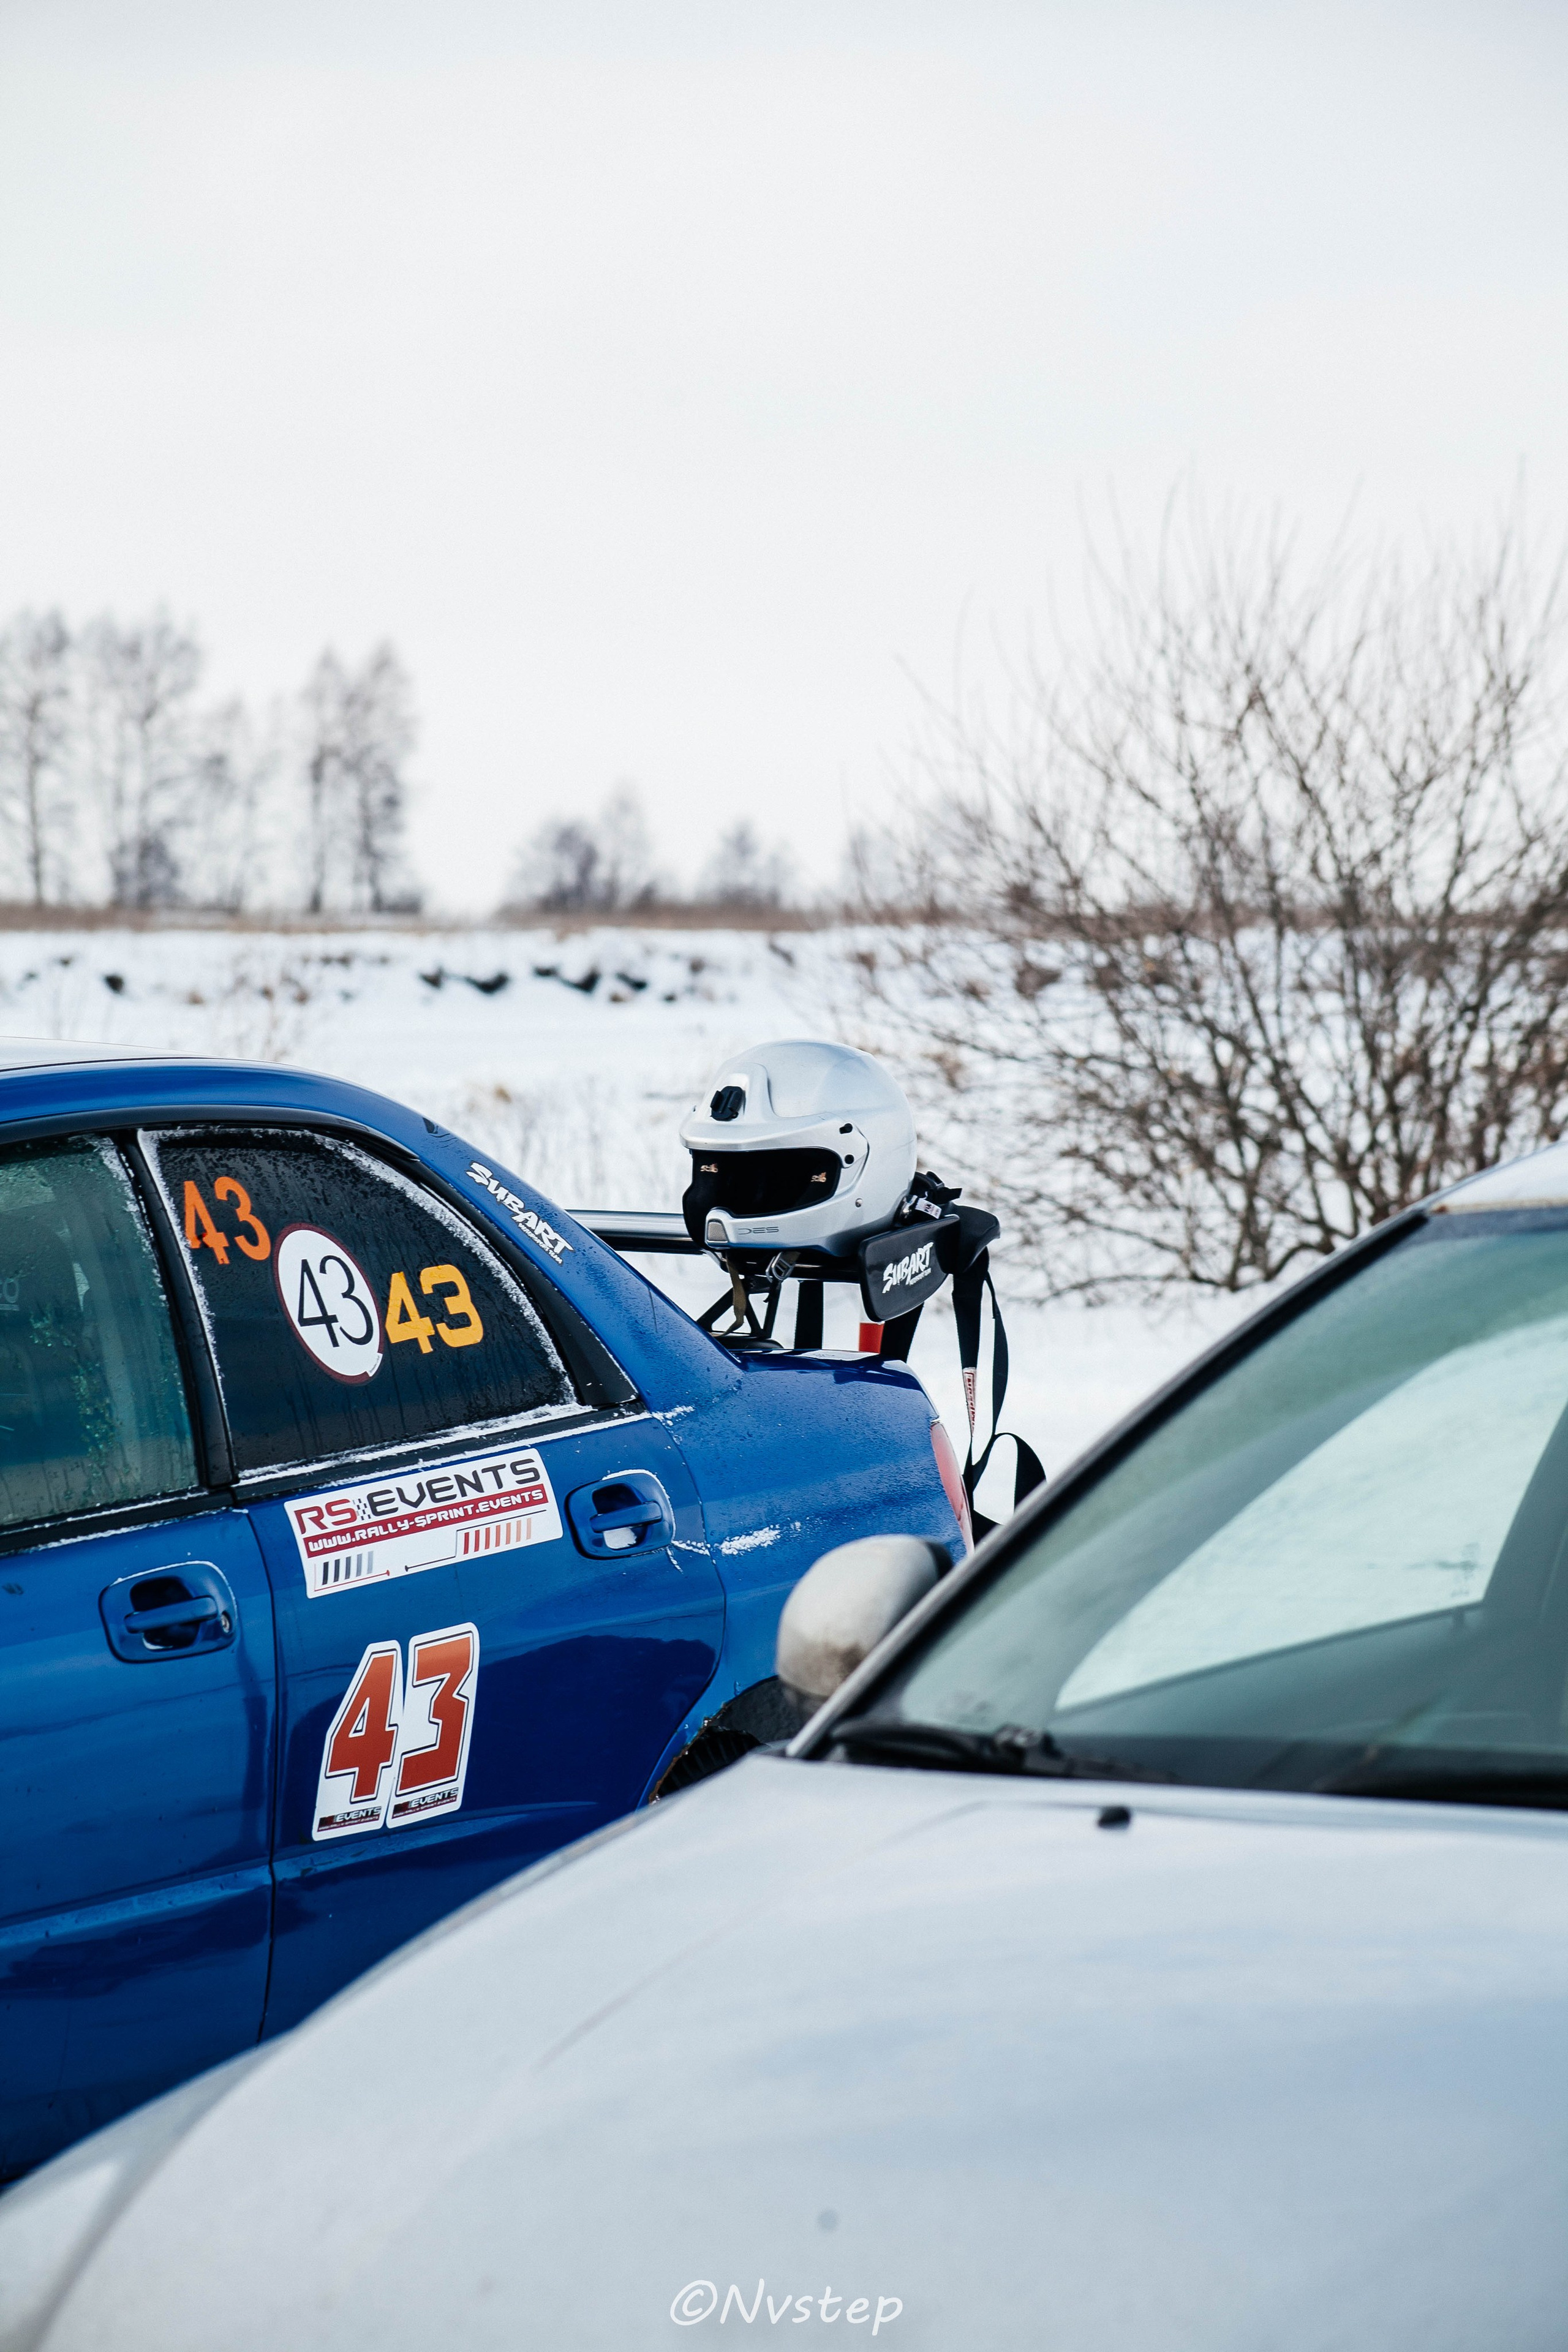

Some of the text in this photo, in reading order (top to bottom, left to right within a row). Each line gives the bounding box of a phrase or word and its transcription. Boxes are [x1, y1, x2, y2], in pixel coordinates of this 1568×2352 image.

[184, 1176, 271, 1265] 43
[466, 1161, 575, 1254] SUBART
[298, 1255, 374, 1348] 43
[385, 1264, 484, 1354] 43
[882, 1242, 934, 1294] SUBART
[294, 1458, 540, 1534] RS EVENTS
[307, 1488, 544, 1553] WWW.RALLY-SPRINT.EVENTS
[326, 1632, 473, 1803] 43
[336, 1806, 382, 1822] EVENTS
[410, 1787, 459, 1807] EVENTS
